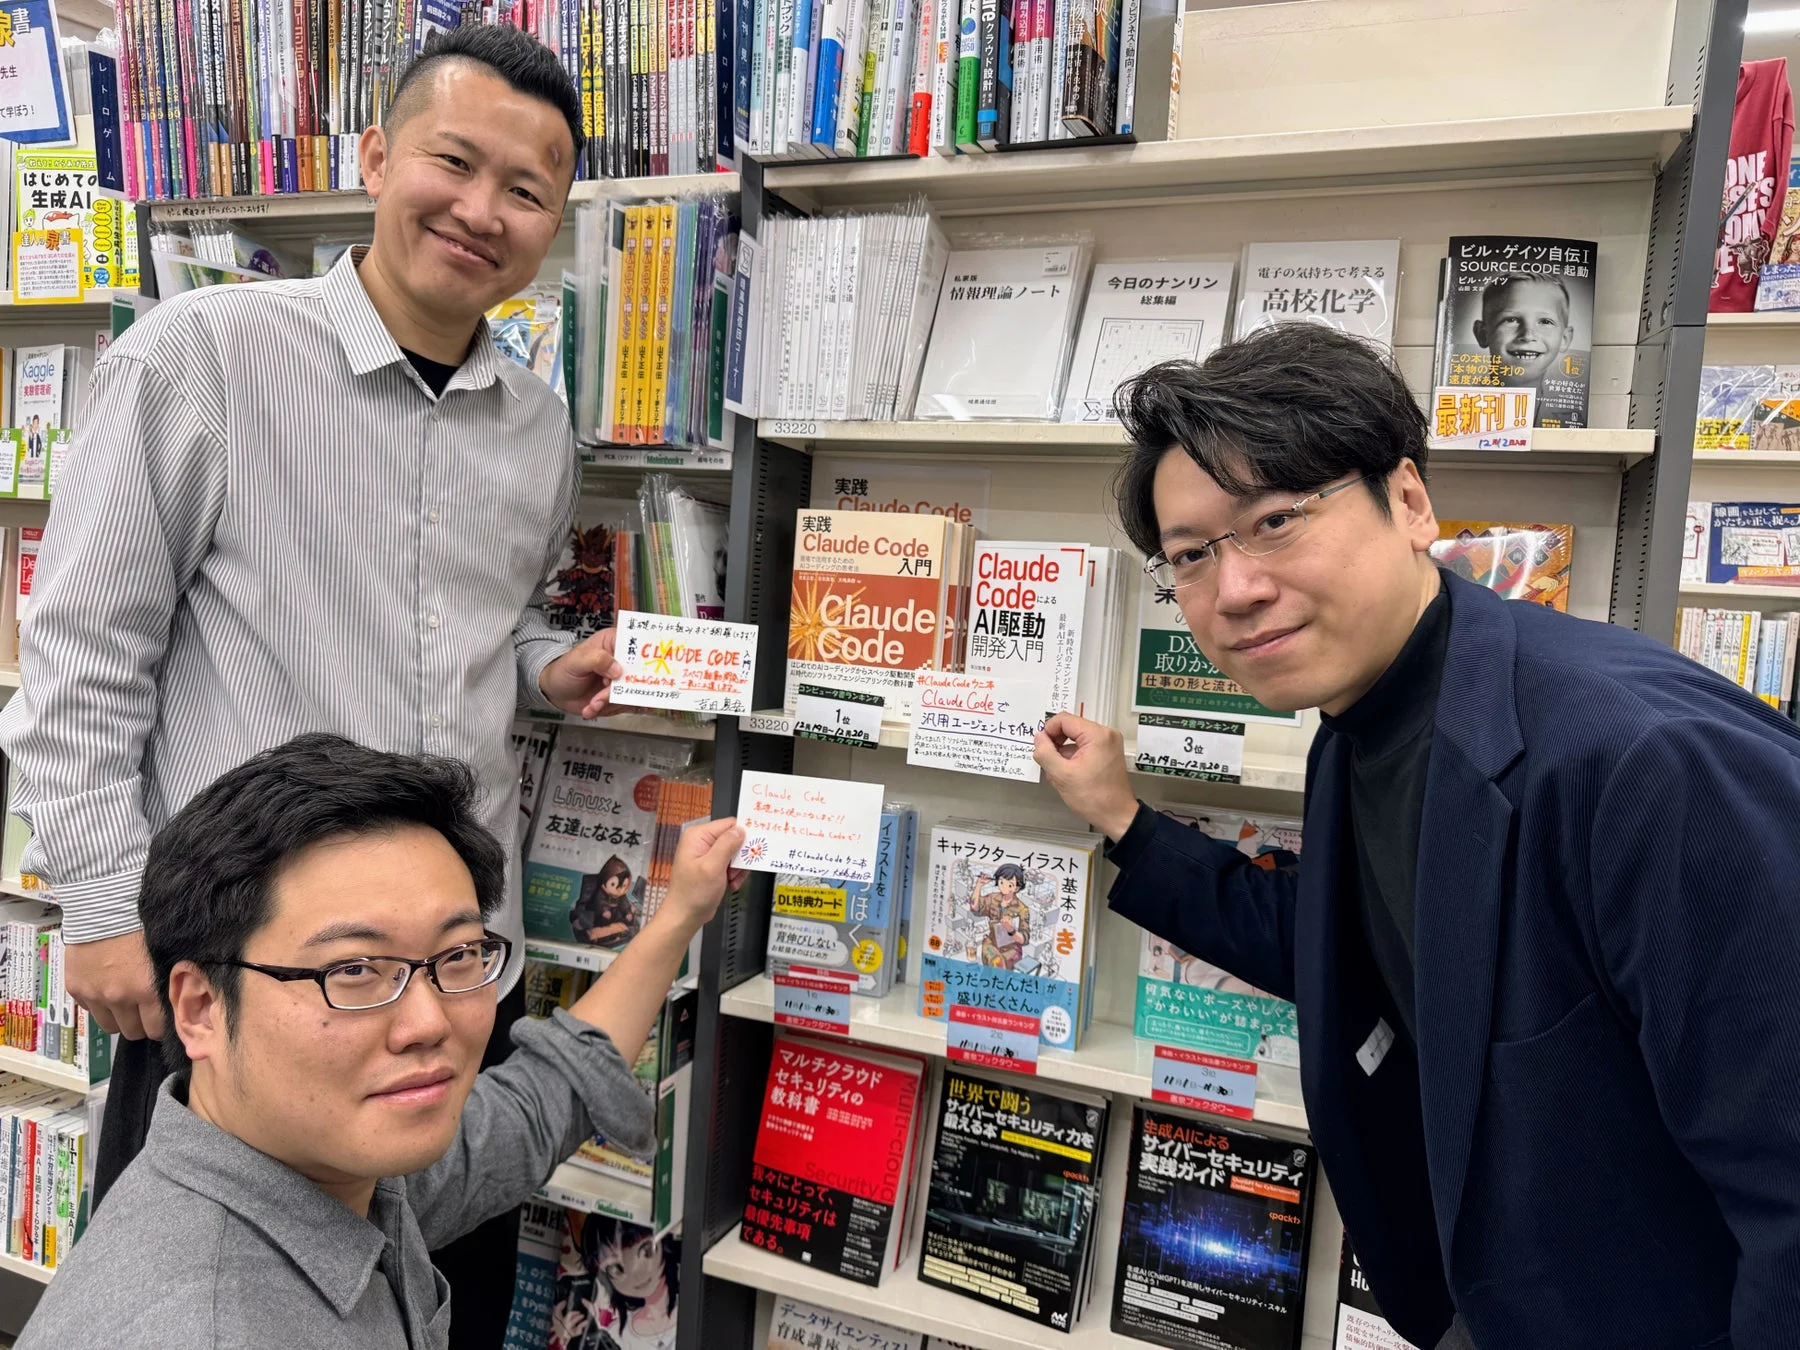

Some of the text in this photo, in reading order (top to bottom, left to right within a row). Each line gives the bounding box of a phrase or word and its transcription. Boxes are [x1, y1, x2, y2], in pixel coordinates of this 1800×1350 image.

[99, 62, 116, 182] レトロゲーム
[23, 172, 98, 188] はじめての
[31, 189, 92, 210] 生成AI
[1258, 266, 1385, 279] 電子の気持ちで考える
[1458, 276, 1509, 286] ビル・ゲイツ
[1459, 261, 1589, 278] SOURCE CODE 起動
[950, 284, 1061, 301] 情報理論ノート
[1108, 276, 1218, 290] 今日のナンリン
[1140, 295, 1177, 306] 総集編
[1262, 288, 1377, 314] 高校化学
[1450, 352, 1502, 365] この本には
[1450, 363, 1525, 377] 「本物の天才」の
[22, 361, 55, 382] Kaggle
[1449, 374, 1506, 387] 速度がある。
[774, 421, 817, 434] 33220
[834, 477, 869, 497] 実践
[802, 515, 832, 533] 実践
[803, 533, 929, 558] Claude Code
[897, 558, 933, 577] 入門
[978, 552, 1060, 583] Claude
[976, 581, 1057, 611] Code による
[819, 593, 936, 634] Claude
[974, 608, 1046, 640] AI駆動
[640, 642, 741, 667] CLAUDE CODE
[816, 627, 905, 665] Code
[971, 635, 1044, 663] 開発入門
[798, 683, 882, 704] コンピュータ書ランキング
[921, 688, 1010, 713] Claude Code で
[750, 718, 790, 731] 33220
[835, 708, 851, 725] 1位
[1139, 714, 1240, 733] コンピュータ書ランキング
[1183, 736, 1204, 755] 3位
[562, 759, 614, 784] 1時間で
[751, 783, 827, 804] Claude Code
[545, 814, 642, 849] 友達になる本
[937, 836, 1080, 874] キャラクターイラスト
[778, 894, 844, 910] DL特典カード
[771, 944, 828, 960] お絵描きのはじめ方
[775, 931, 837, 950] 背伸びしない
[957, 991, 1041, 1014] 盛りだくさん。
[779, 1049, 884, 1090] マルチクラウド
[774, 1068, 864, 1107] セキュリティの
[949, 1078, 1032, 1116] 世界で闘う
[770, 1086, 820, 1117] 教科書
[943, 1113, 999, 1140] 鍛える本
[945, 1098, 1095, 1150] サイバーセキュリティ力を
[1143, 1118, 1230, 1151] 生成AIによる
[1139, 1152, 1227, 1189] 実践ガイド
[1142, 1135, 1304, 1188] サイバーセキュリティ
[751, 1164, 835, 1206] 我々にとって、
[749, 1184, 838, 1228] セキュリティは
[744, 1204, 813, 1242] 最優先事項
[742, 1224, 784, 1255] である。
[777, 1321, 842, 1350] 育成講座
